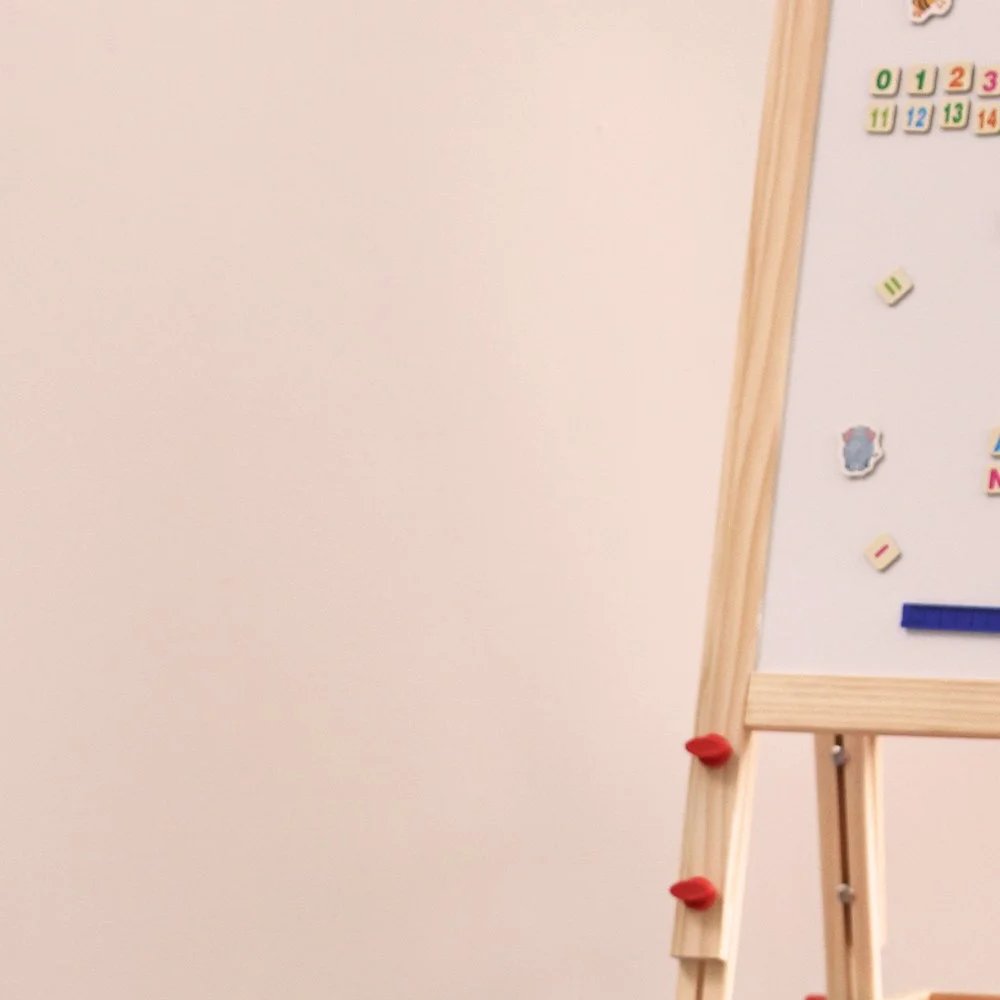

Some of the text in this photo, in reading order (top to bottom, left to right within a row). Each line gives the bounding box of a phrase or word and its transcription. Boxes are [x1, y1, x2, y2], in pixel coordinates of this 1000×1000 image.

[876, 66, 998, 92] 0 1 2 3
[869, 103, 997, 129] 11 12 13 14
